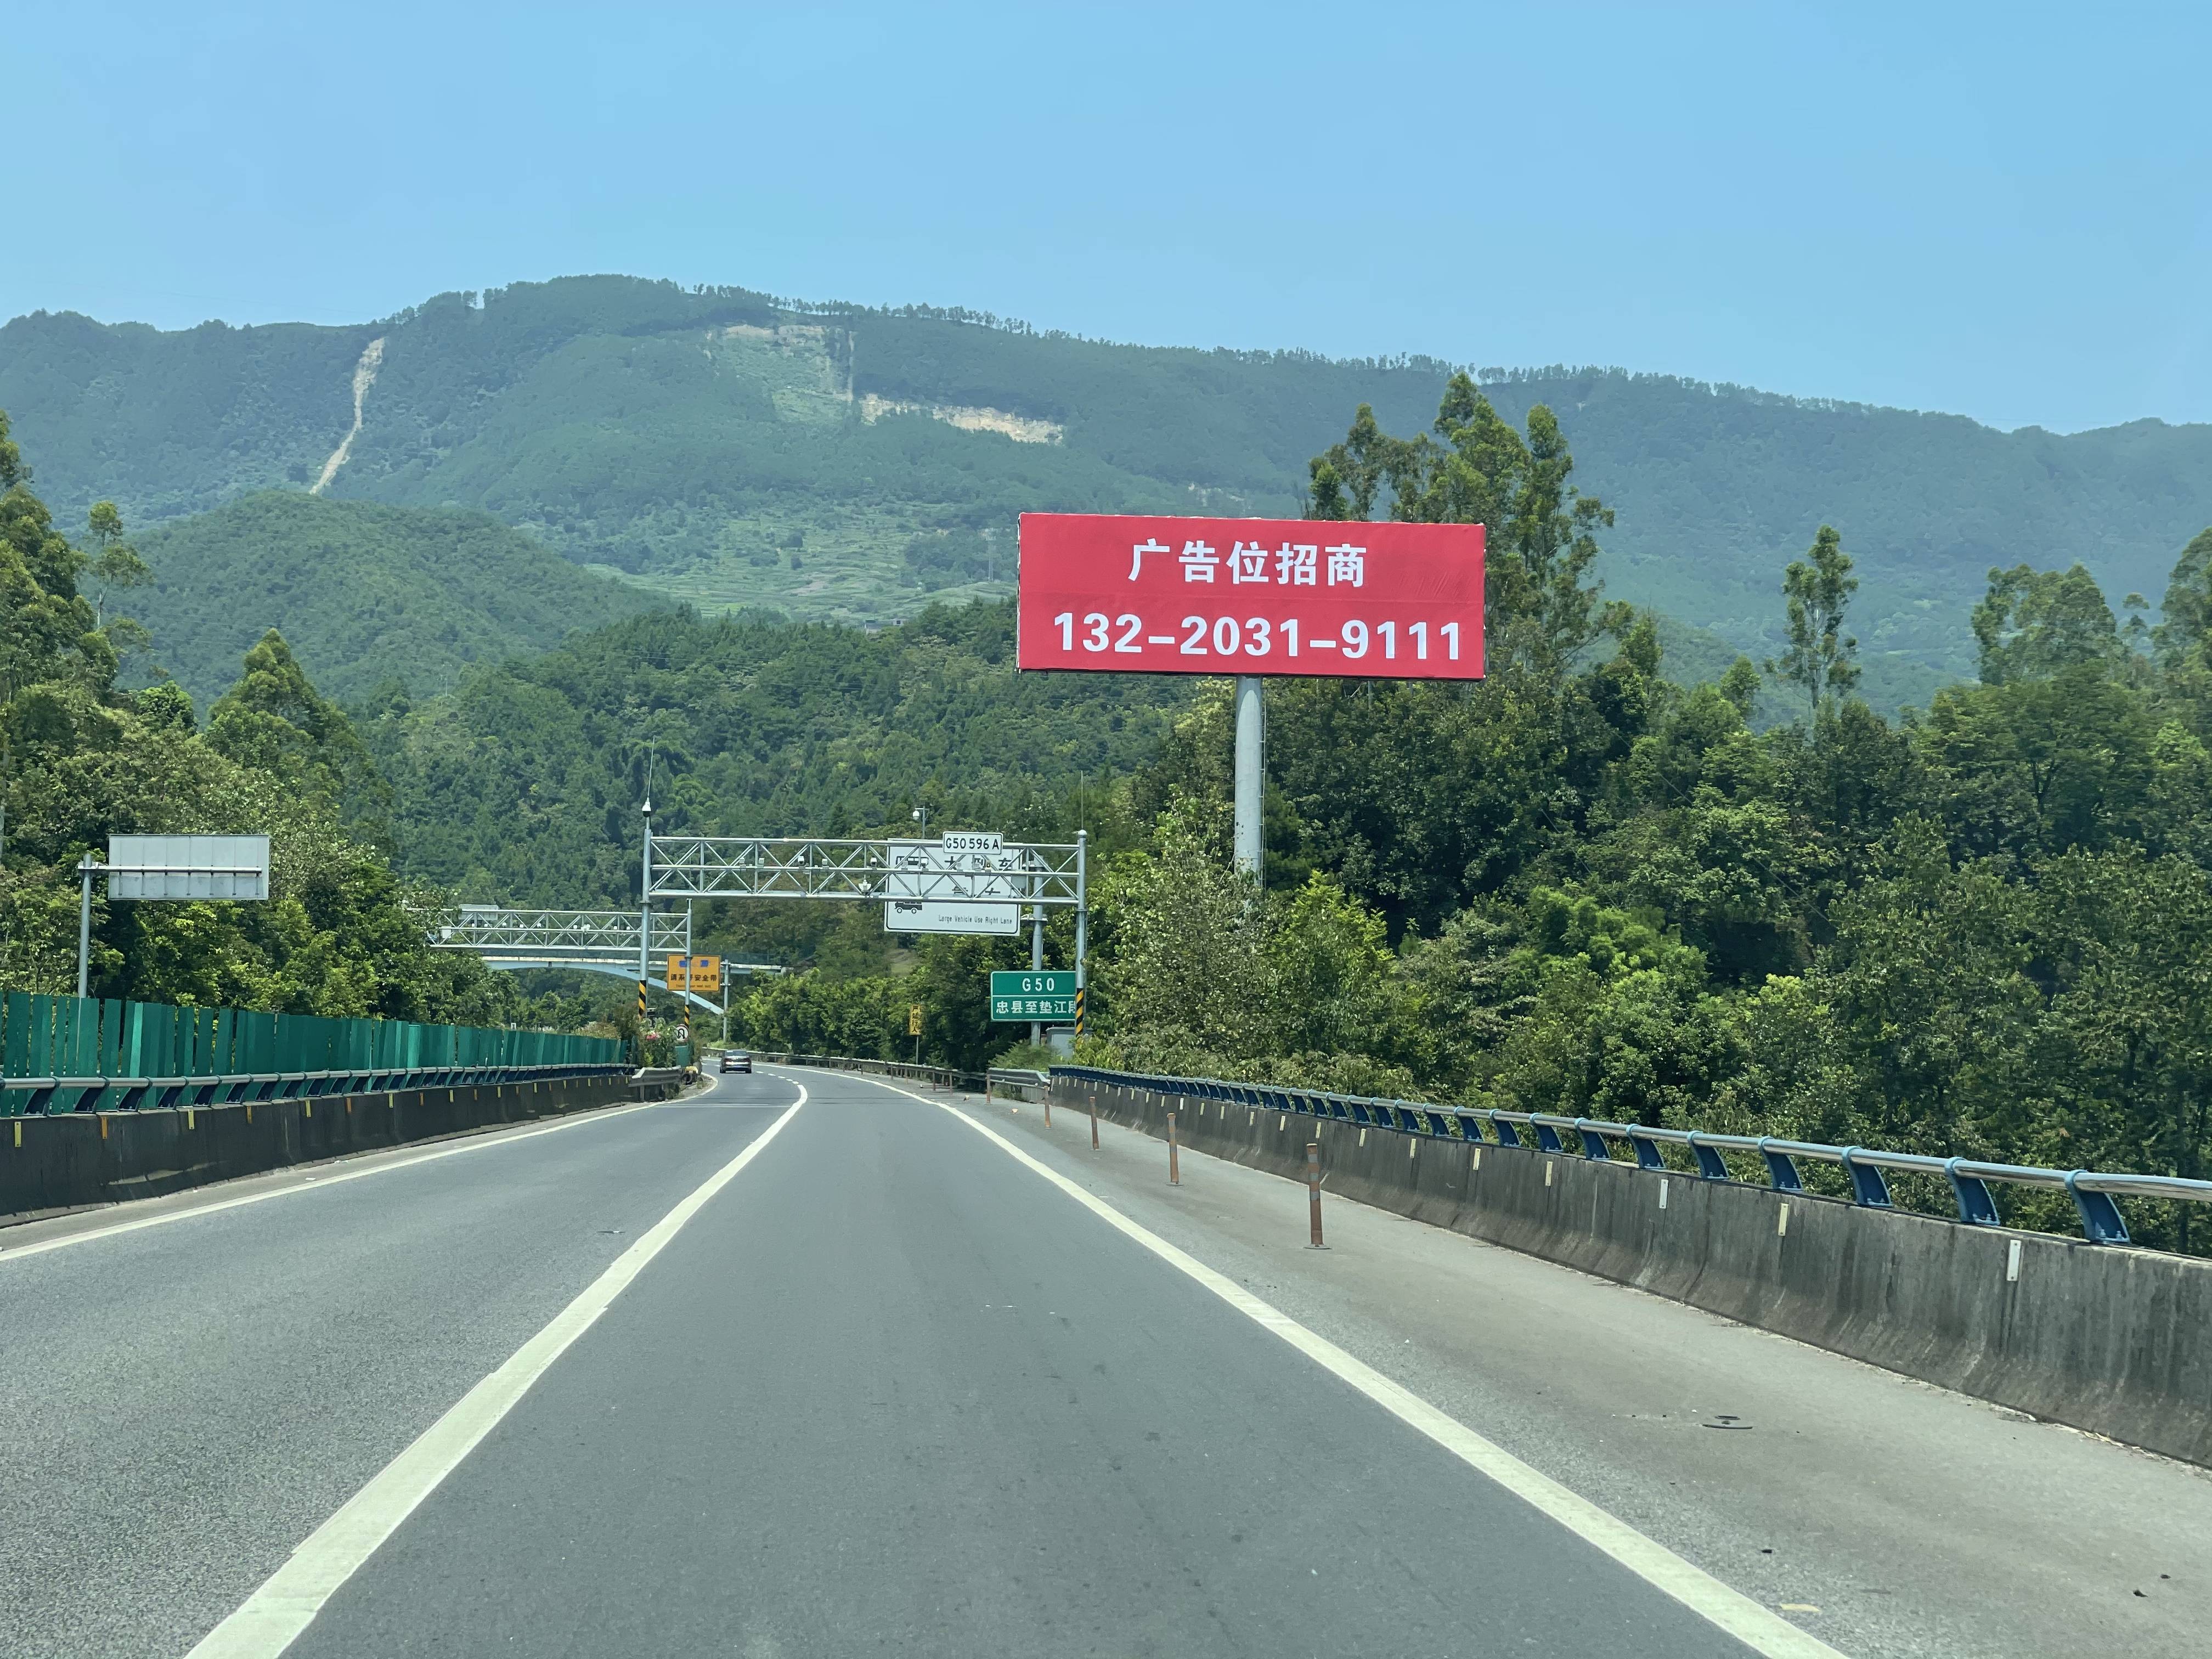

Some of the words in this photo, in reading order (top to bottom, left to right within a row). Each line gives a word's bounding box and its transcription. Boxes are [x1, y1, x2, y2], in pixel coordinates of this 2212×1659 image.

[1128, 538, 1368, 588] 广告位招商
[1054, 612, 1460, 661] 132-2031-9111
[946, 837, 966, 849] G50
[969, 838, 989, 850] 596
[992, 838, 1000, 850] A
[939, 915, 952, 924] Large
[985, 916, 998, 925] Right
[1022, 977, 1055, 992] G50
